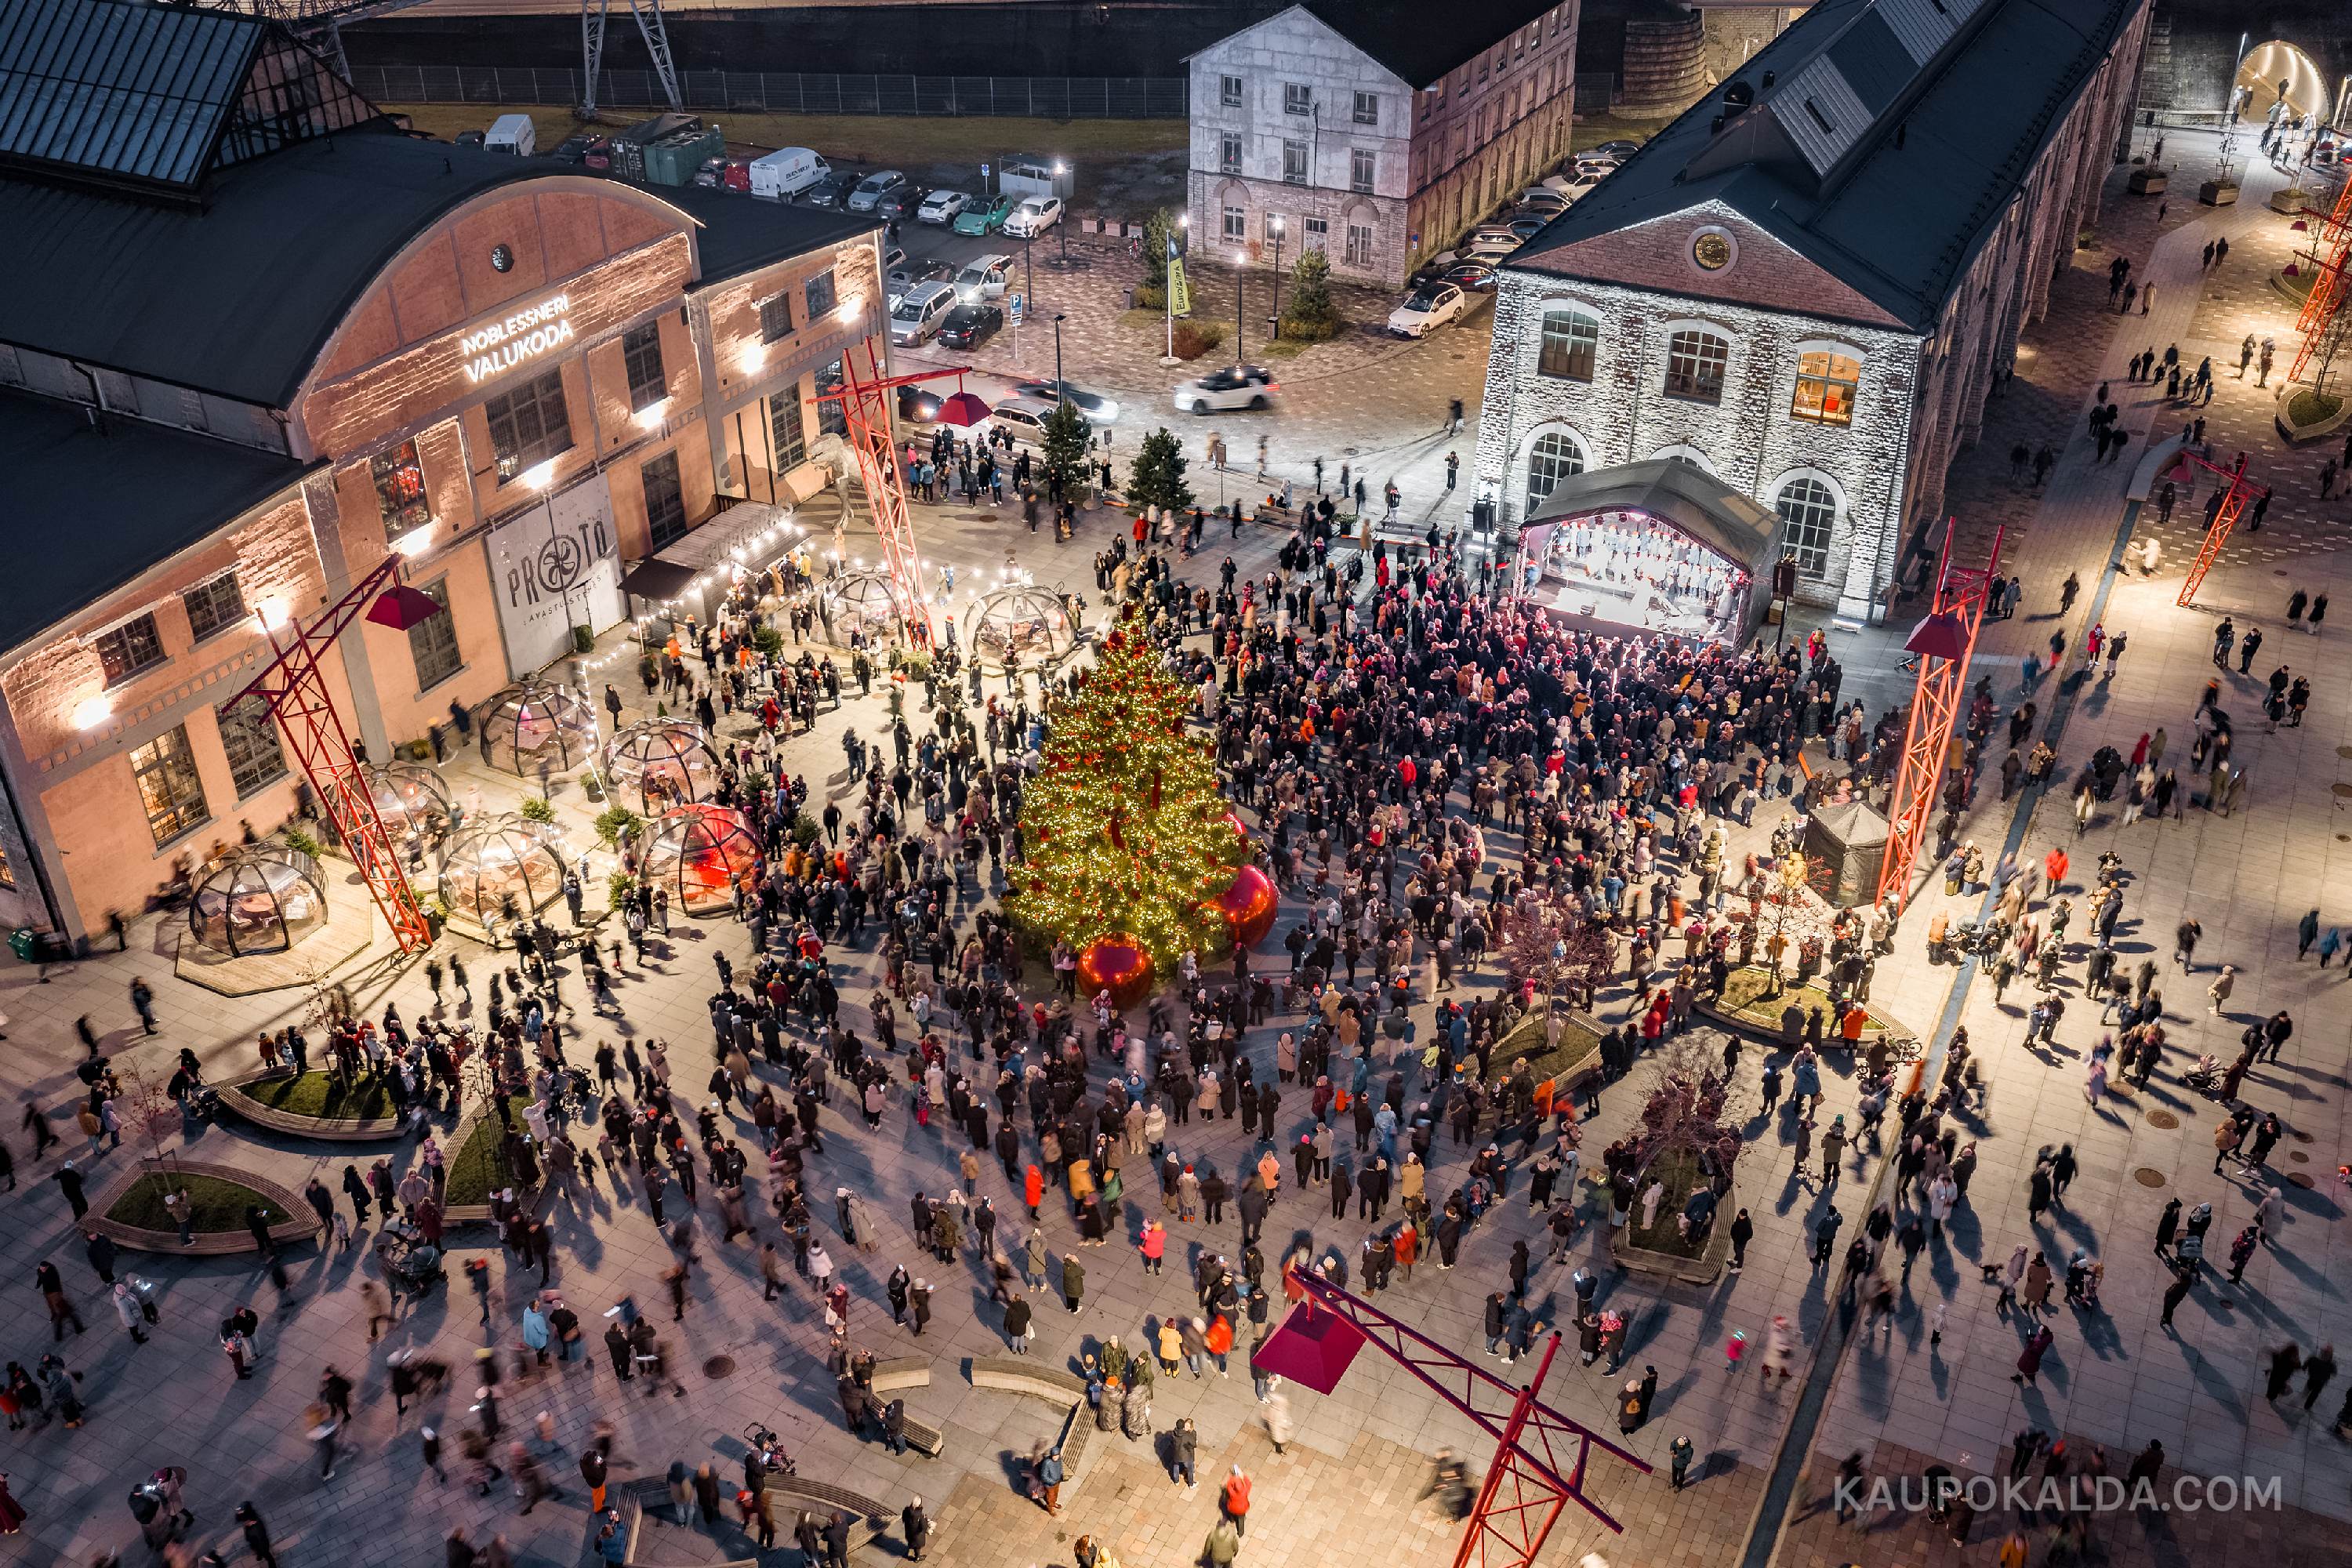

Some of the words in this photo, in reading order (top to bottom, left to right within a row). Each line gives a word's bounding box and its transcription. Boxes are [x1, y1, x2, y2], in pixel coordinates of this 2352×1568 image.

[1013, 296, 1020, 307] P
[1173, 265, 1185, 310] EuroPark
[461, 294, 569, 356] NOBLESSNERI
[464, 319, 574, 383] VALUKODA
